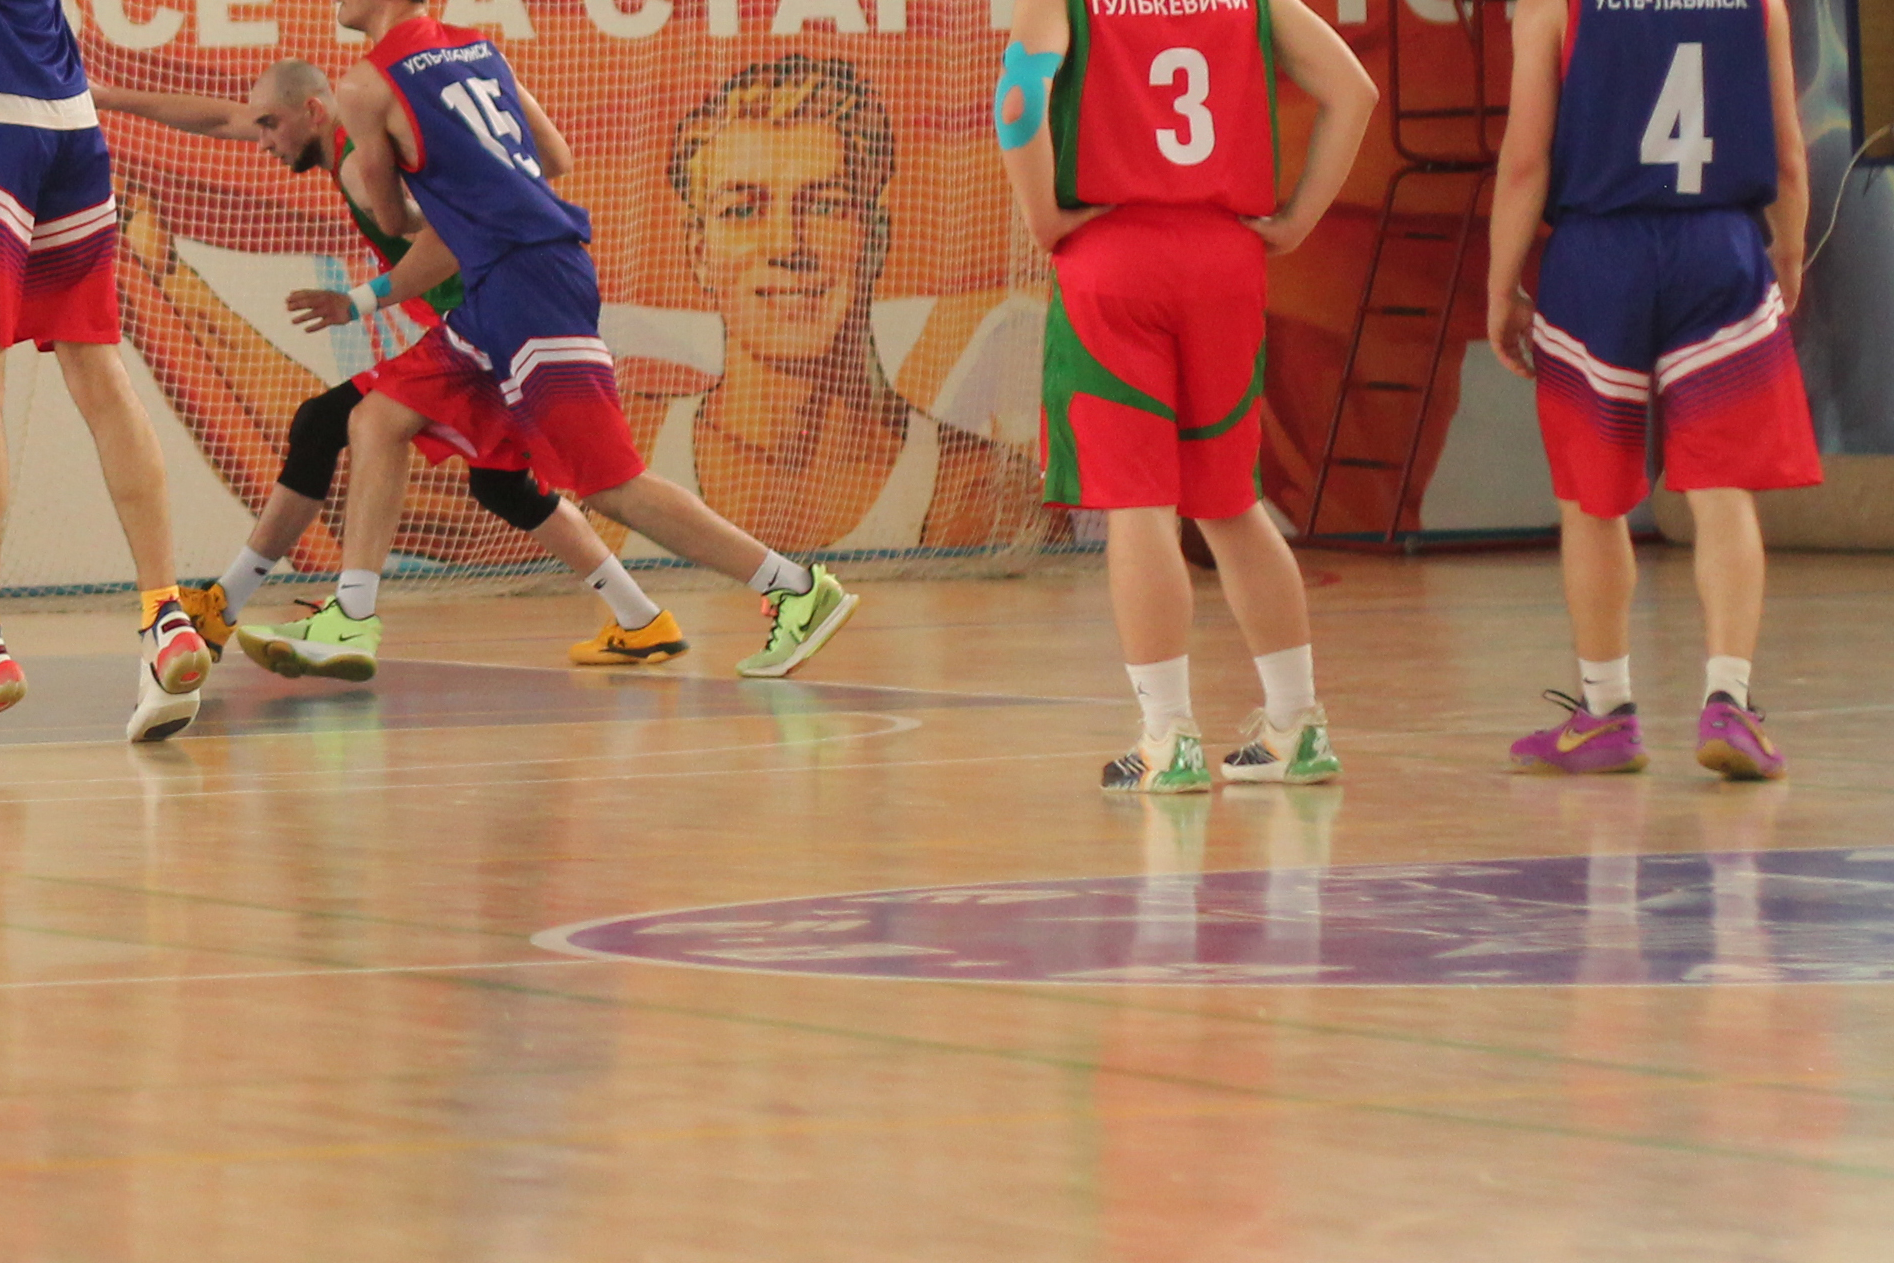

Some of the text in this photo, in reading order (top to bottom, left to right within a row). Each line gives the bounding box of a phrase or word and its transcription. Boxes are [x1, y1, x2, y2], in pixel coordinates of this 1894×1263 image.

[439, 76, 542, 179] 15
[1148, 47, 1216, 166] 3
[1640, 42, 1714, 194] 4
